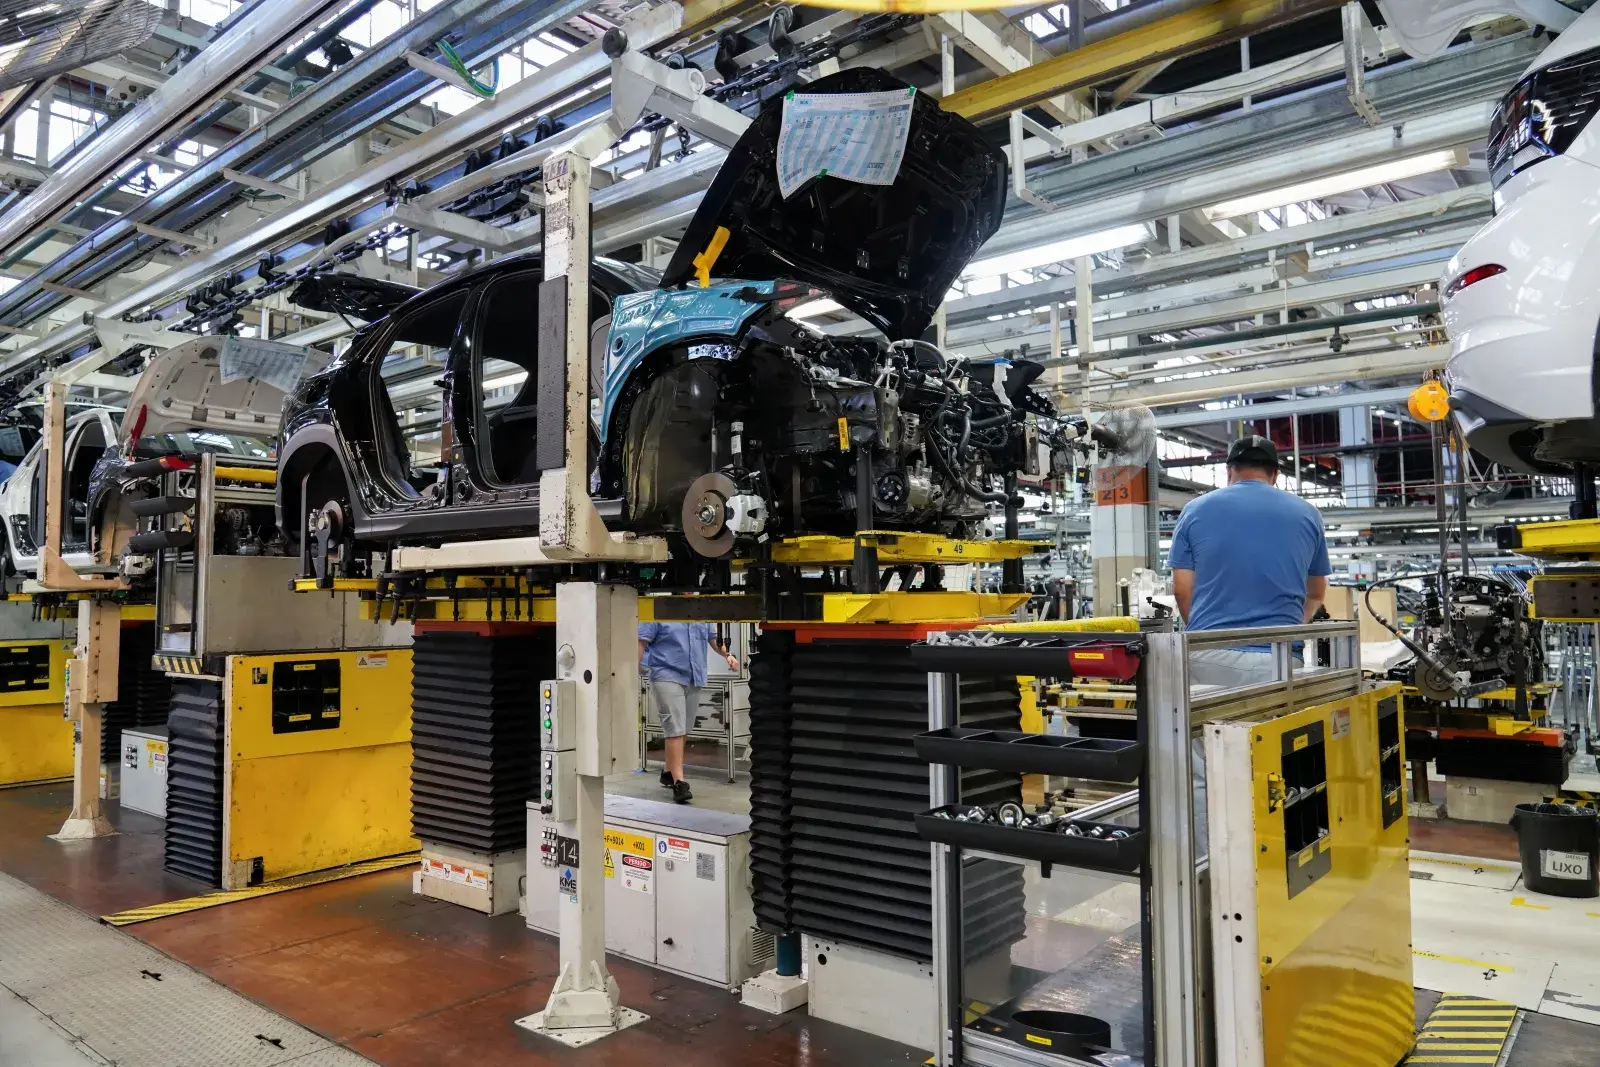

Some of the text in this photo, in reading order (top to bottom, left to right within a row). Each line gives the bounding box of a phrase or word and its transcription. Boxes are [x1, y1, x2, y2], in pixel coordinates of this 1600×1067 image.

[1103, 487, 1128, 500] 2 3
[954, 544, 962, 554] 49
[560, 840, 578, 864] 14
[628, 858, 647, 867] PERIGO
[1552, 860, 1582, 875] LIXO
[560, 876, 577, 890] KME
